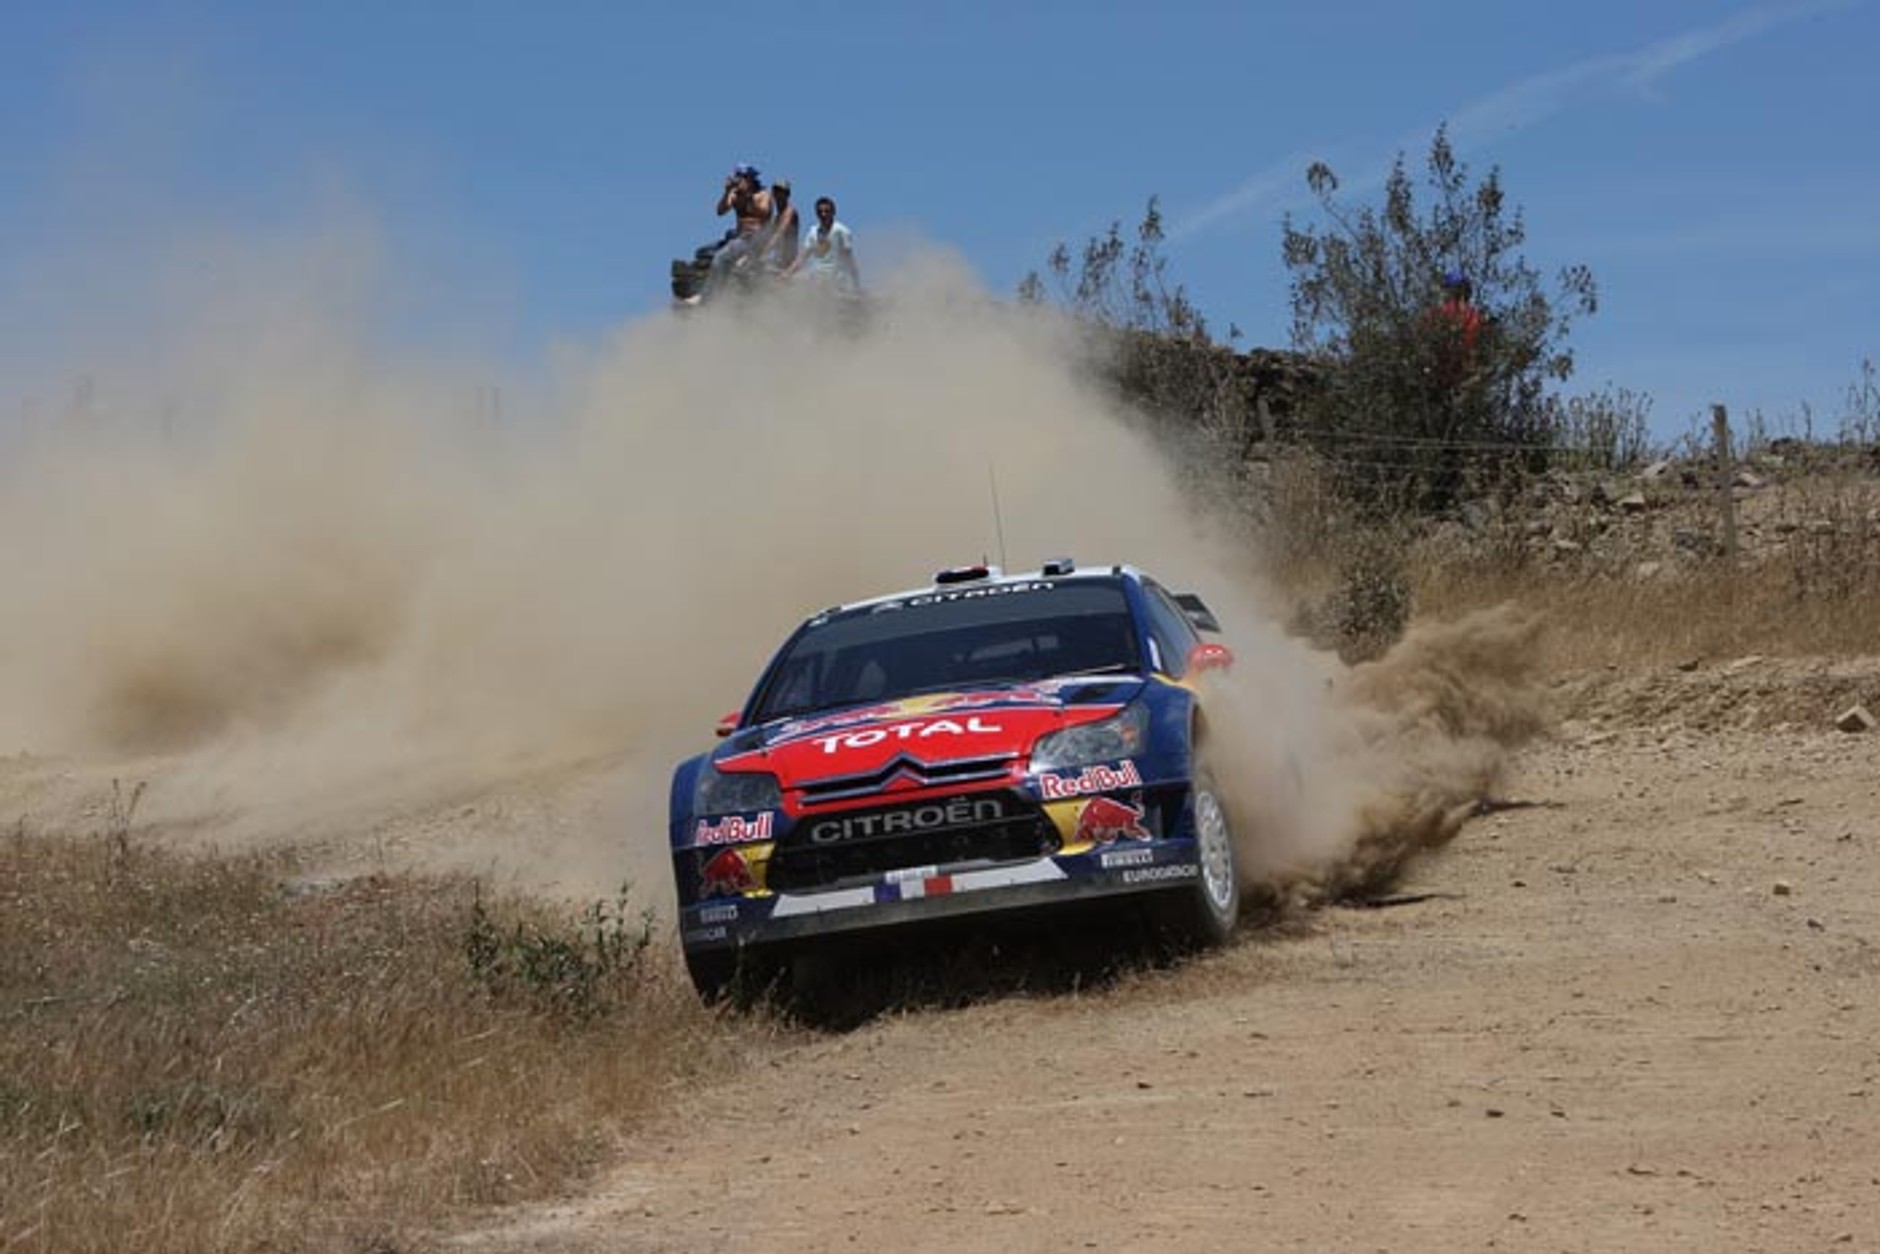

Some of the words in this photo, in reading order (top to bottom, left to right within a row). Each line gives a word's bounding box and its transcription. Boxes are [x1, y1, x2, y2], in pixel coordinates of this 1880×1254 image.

[812, 717, 1003, 753] TOTAL
[1040, 768, 1096, 798] Red
[1095, 760, 1142, 792] Bull
[730, 811, 774, 842] Bull
[811, 795, 1002, 843] CITROËN
